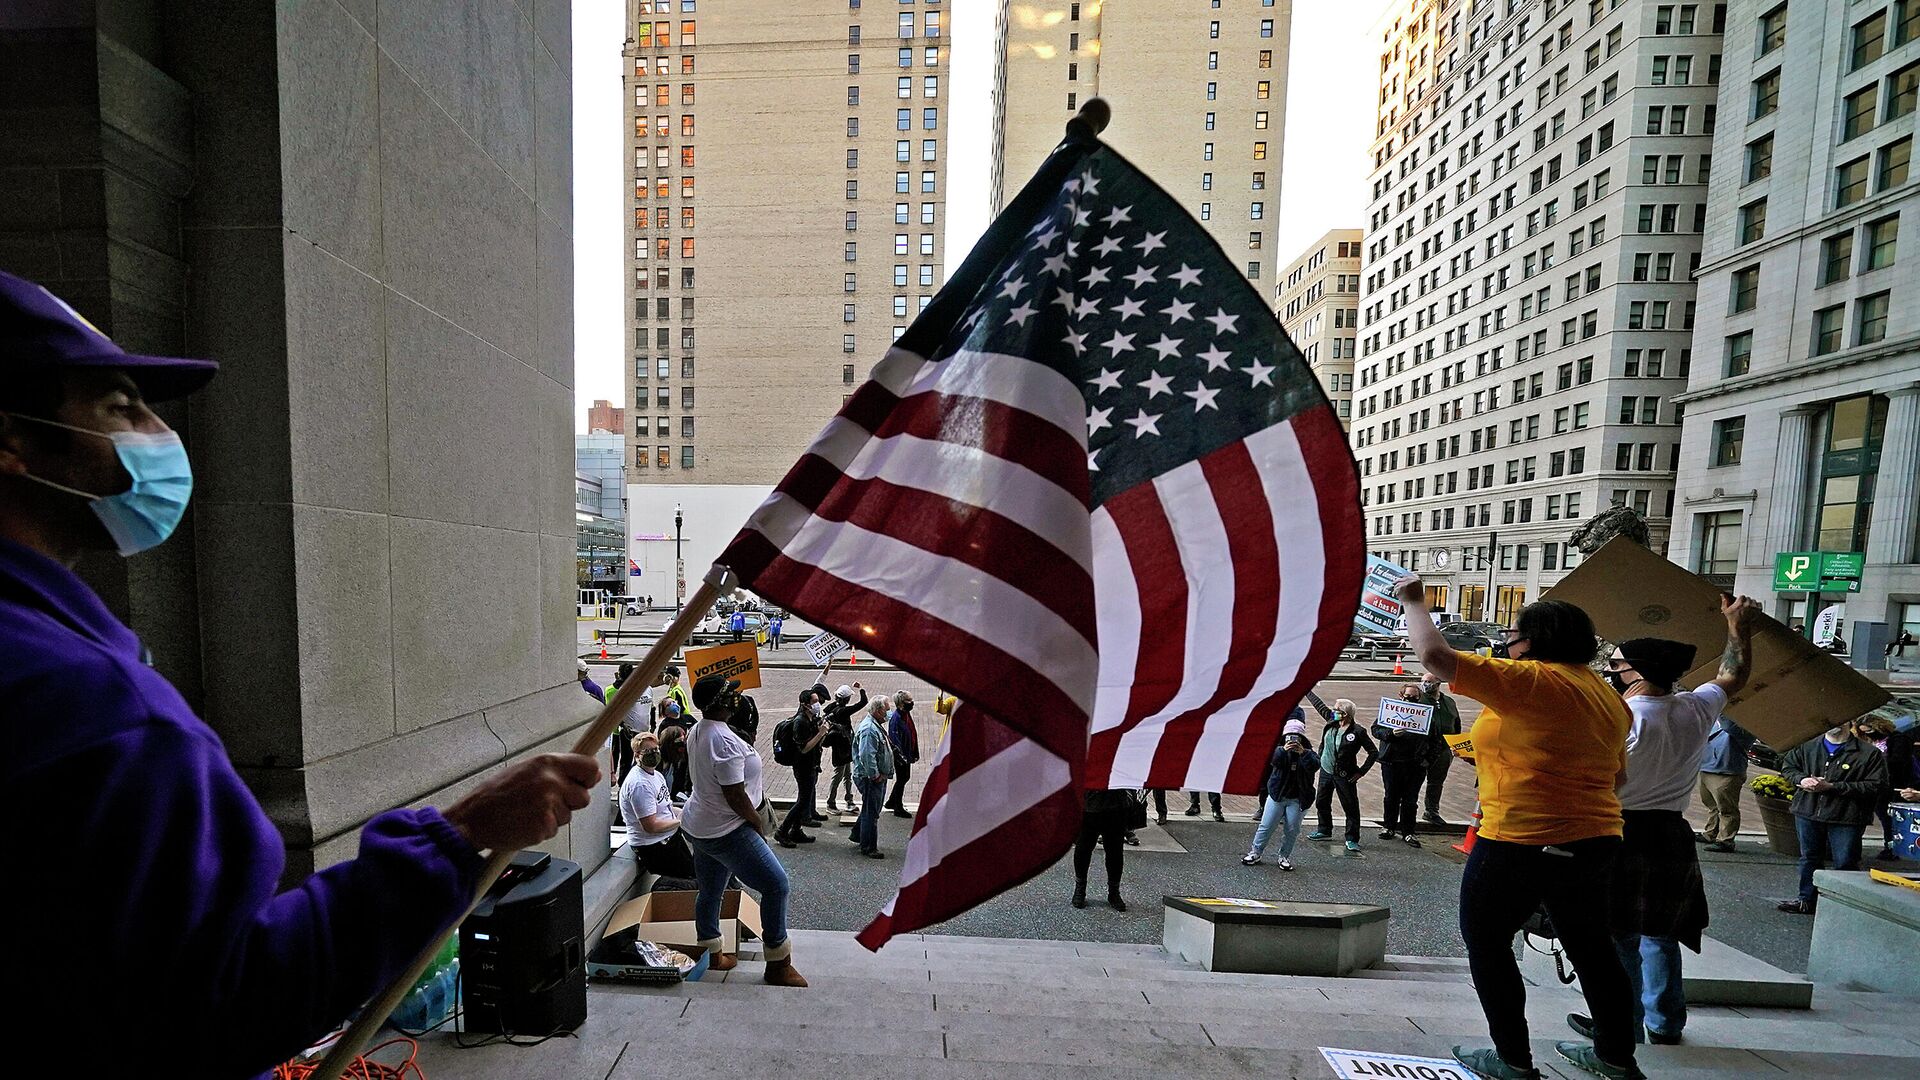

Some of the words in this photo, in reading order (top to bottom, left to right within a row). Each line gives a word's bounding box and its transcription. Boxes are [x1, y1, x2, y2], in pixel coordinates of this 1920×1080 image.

[1373, 597, 1378, 607] it
[1379, 600, 1389, 611] has
[1390, 604, 1397, 614] to
[1374, 616, 1382, 624] us
[809, 640, 821, 650] OUR
[815, 638, 841, 660] COUNT
[694, 656, 737, 677] VOTERS
[1385, 704, 1427, 716] EVERYONE
[1386, 718, 1421, 728] COUNTS!
[1351, 1060, 1463, 1080] COUNT
